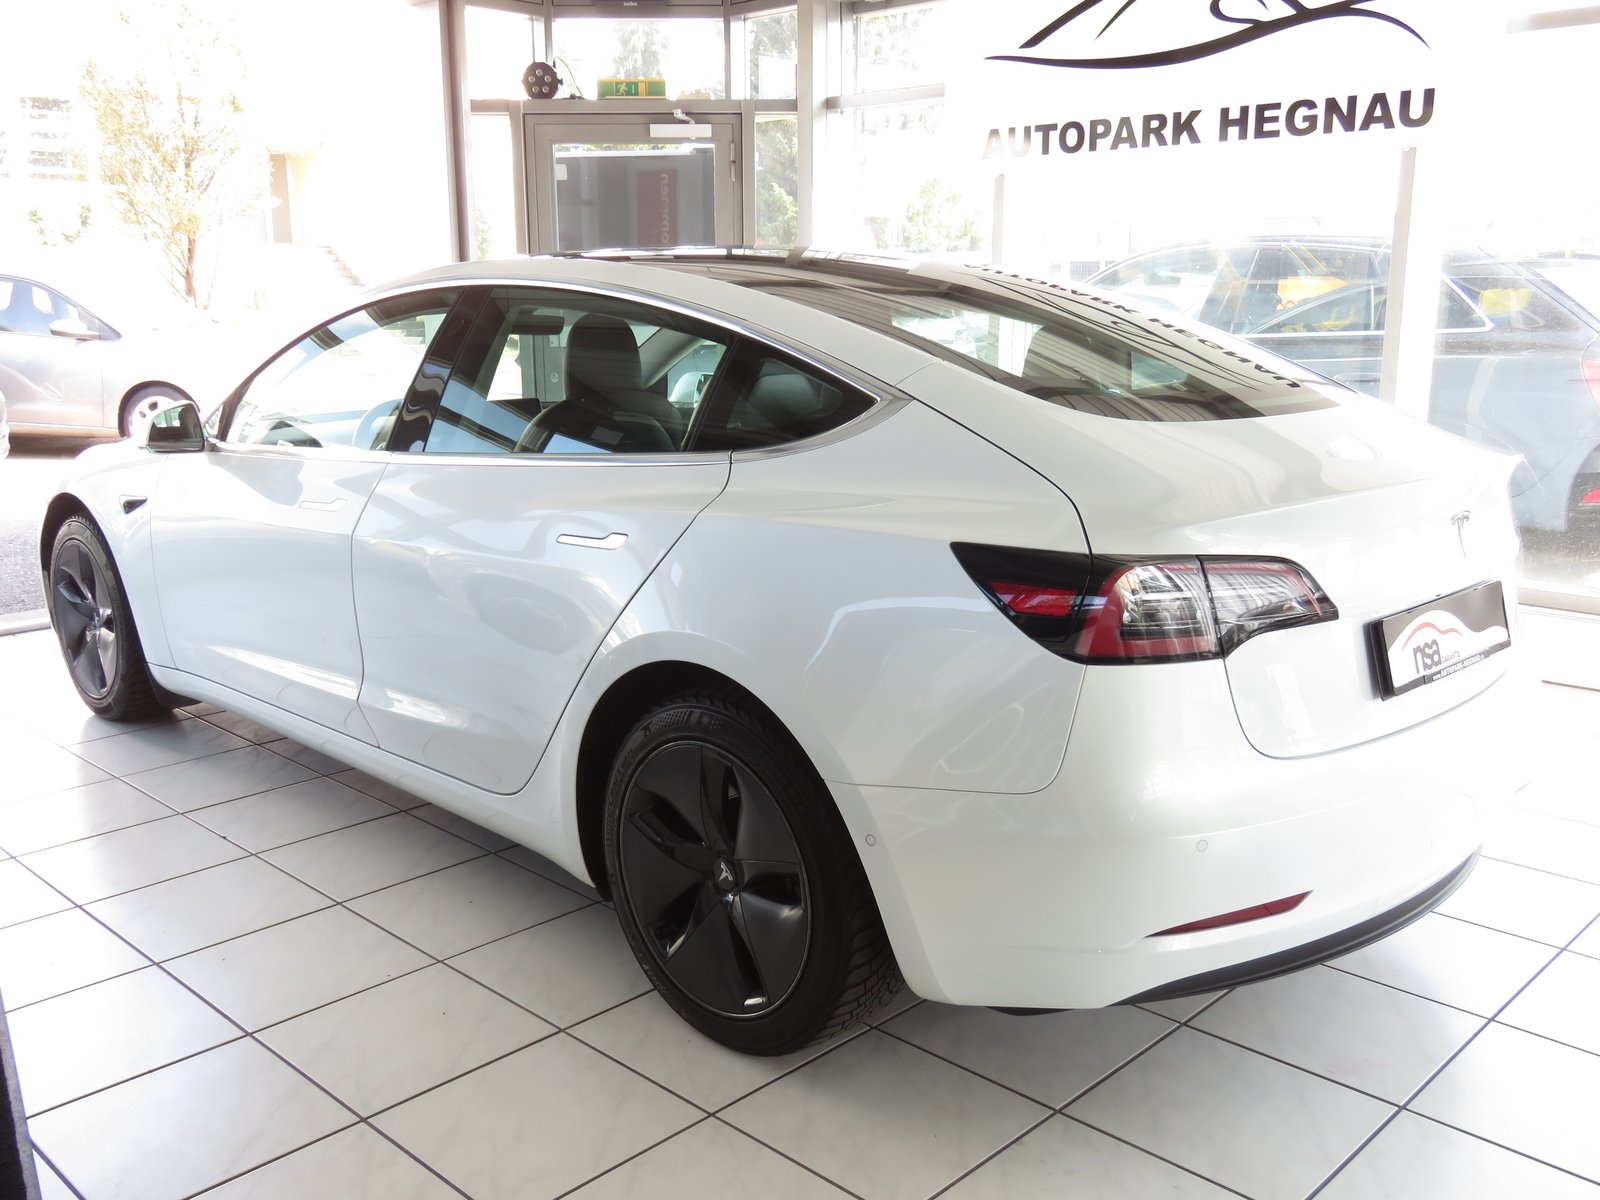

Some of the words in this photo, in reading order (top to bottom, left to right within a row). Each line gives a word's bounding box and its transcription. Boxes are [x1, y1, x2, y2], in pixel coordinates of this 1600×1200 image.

[982, 110, 1202, 160] AUTOPARK
[1218, 88, 1436, 142] HEGNAU
[1413, 639, 1442, 674] nsa
